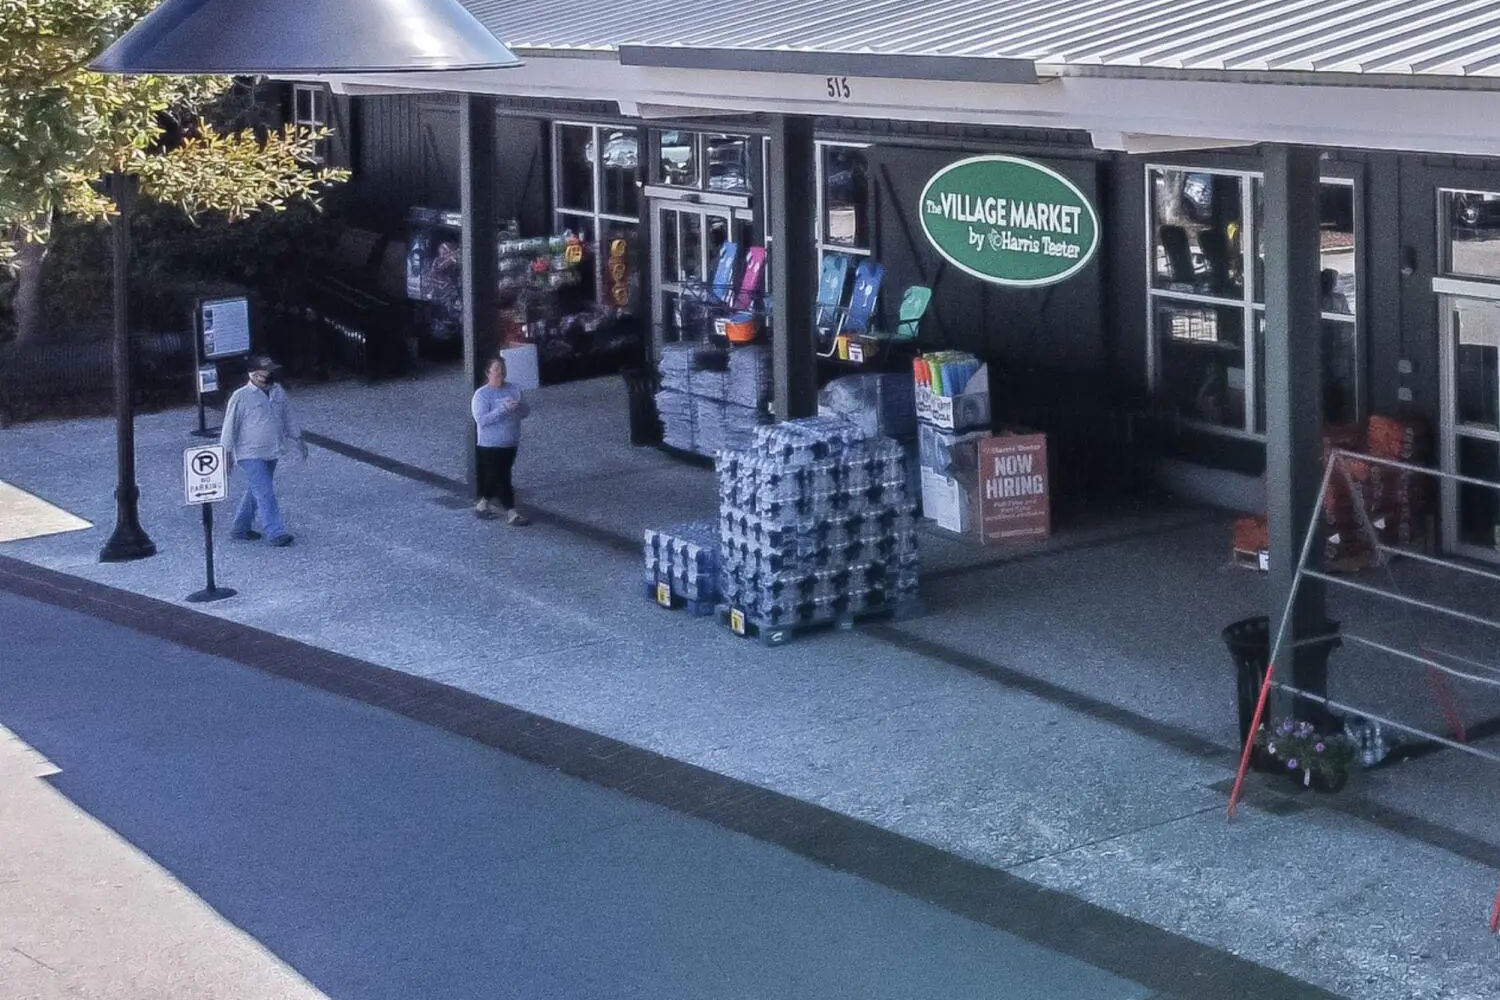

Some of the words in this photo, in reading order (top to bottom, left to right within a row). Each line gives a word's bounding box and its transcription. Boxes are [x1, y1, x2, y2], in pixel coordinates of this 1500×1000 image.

[826, 76, 851, 98] 515
[926, 199, 942, 215] The
[940, 191, 1007, 227] VILLAGE
[1010, 200, 1082, 235] MARKET
[968, 226, 985, 251] by
[1002, 231, 1040, 254] Harris
[1041, 235, 1080, 259] Teeter
[994, 454, 1033, 477] NOW
[985, 474, 1044, 499] HIRING
